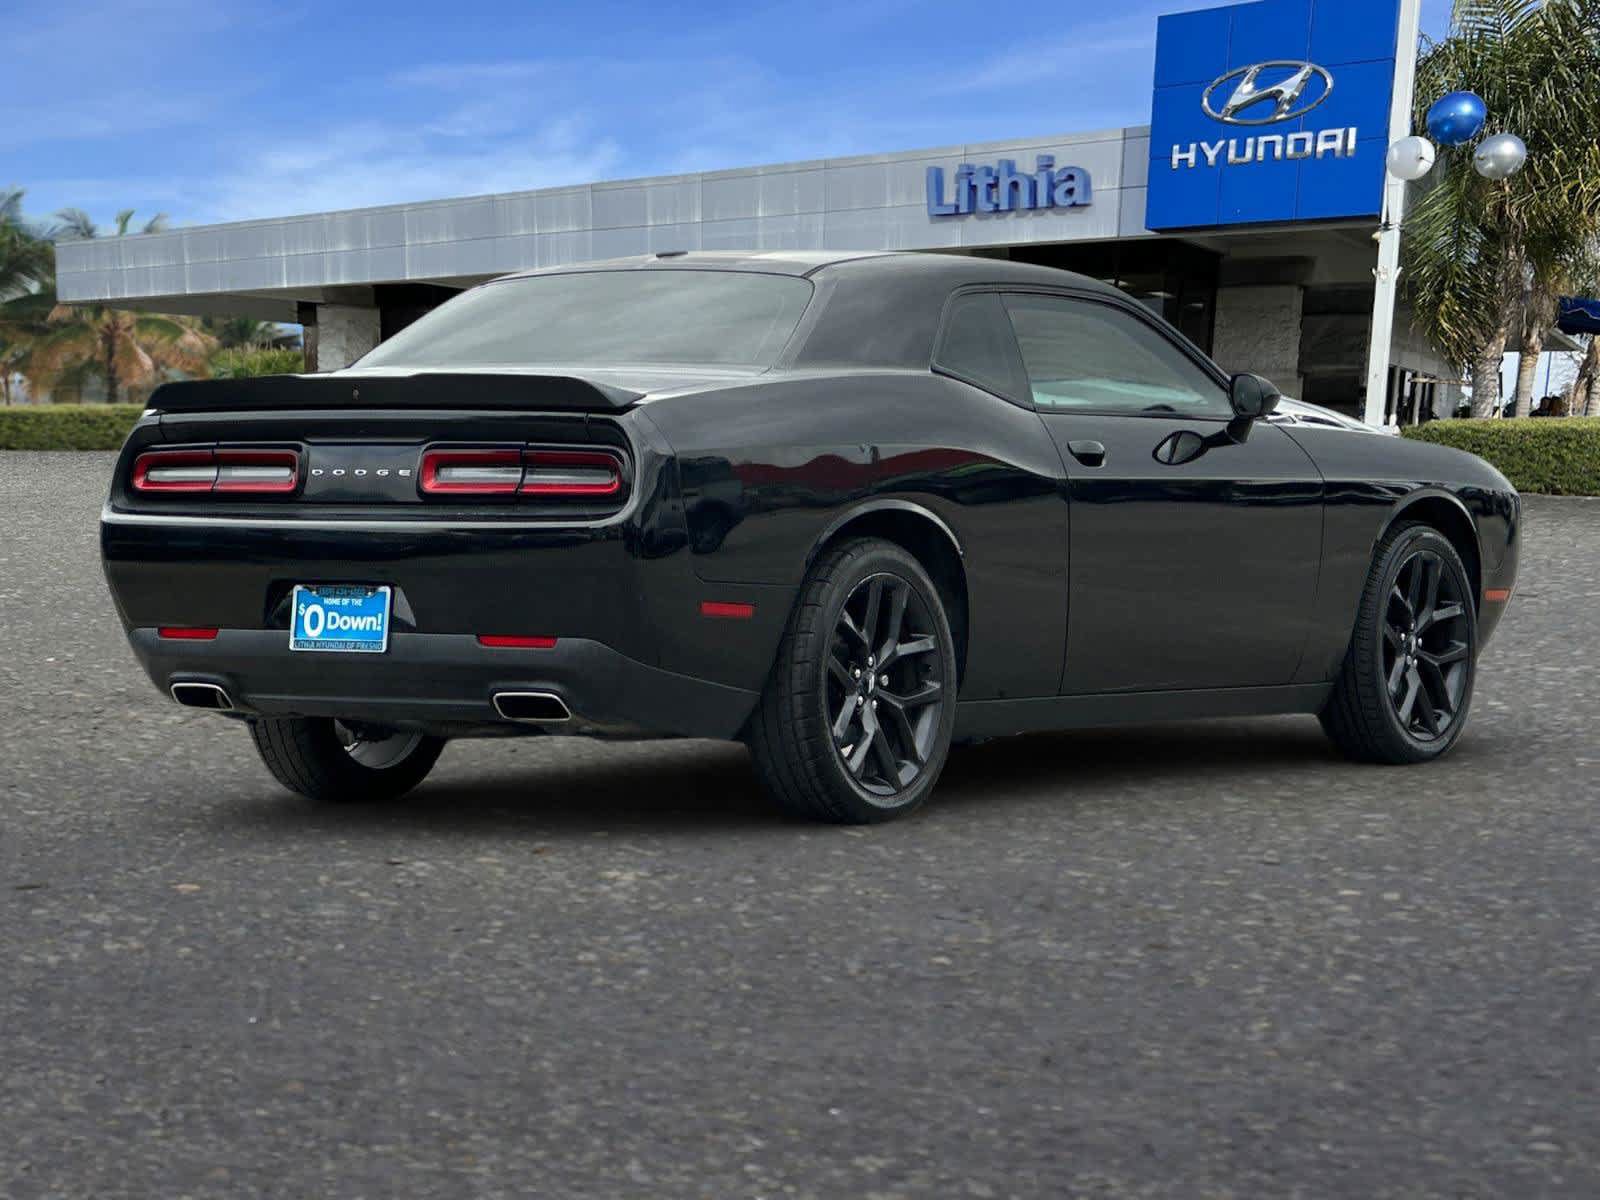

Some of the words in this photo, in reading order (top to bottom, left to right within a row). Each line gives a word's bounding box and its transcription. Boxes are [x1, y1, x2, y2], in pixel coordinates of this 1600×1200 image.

[1170, 127, 1358, 169] HYUNDAI
[925, 154, 1093, 218] Lithia
[311, 468, 412, 477] DODGE
[342, 598, 350, 606] OF
[351, 598, 362, 607] THE
[327, 611, 383, 631] Down!
[315, 641, 346, 650] HYUNDAI
